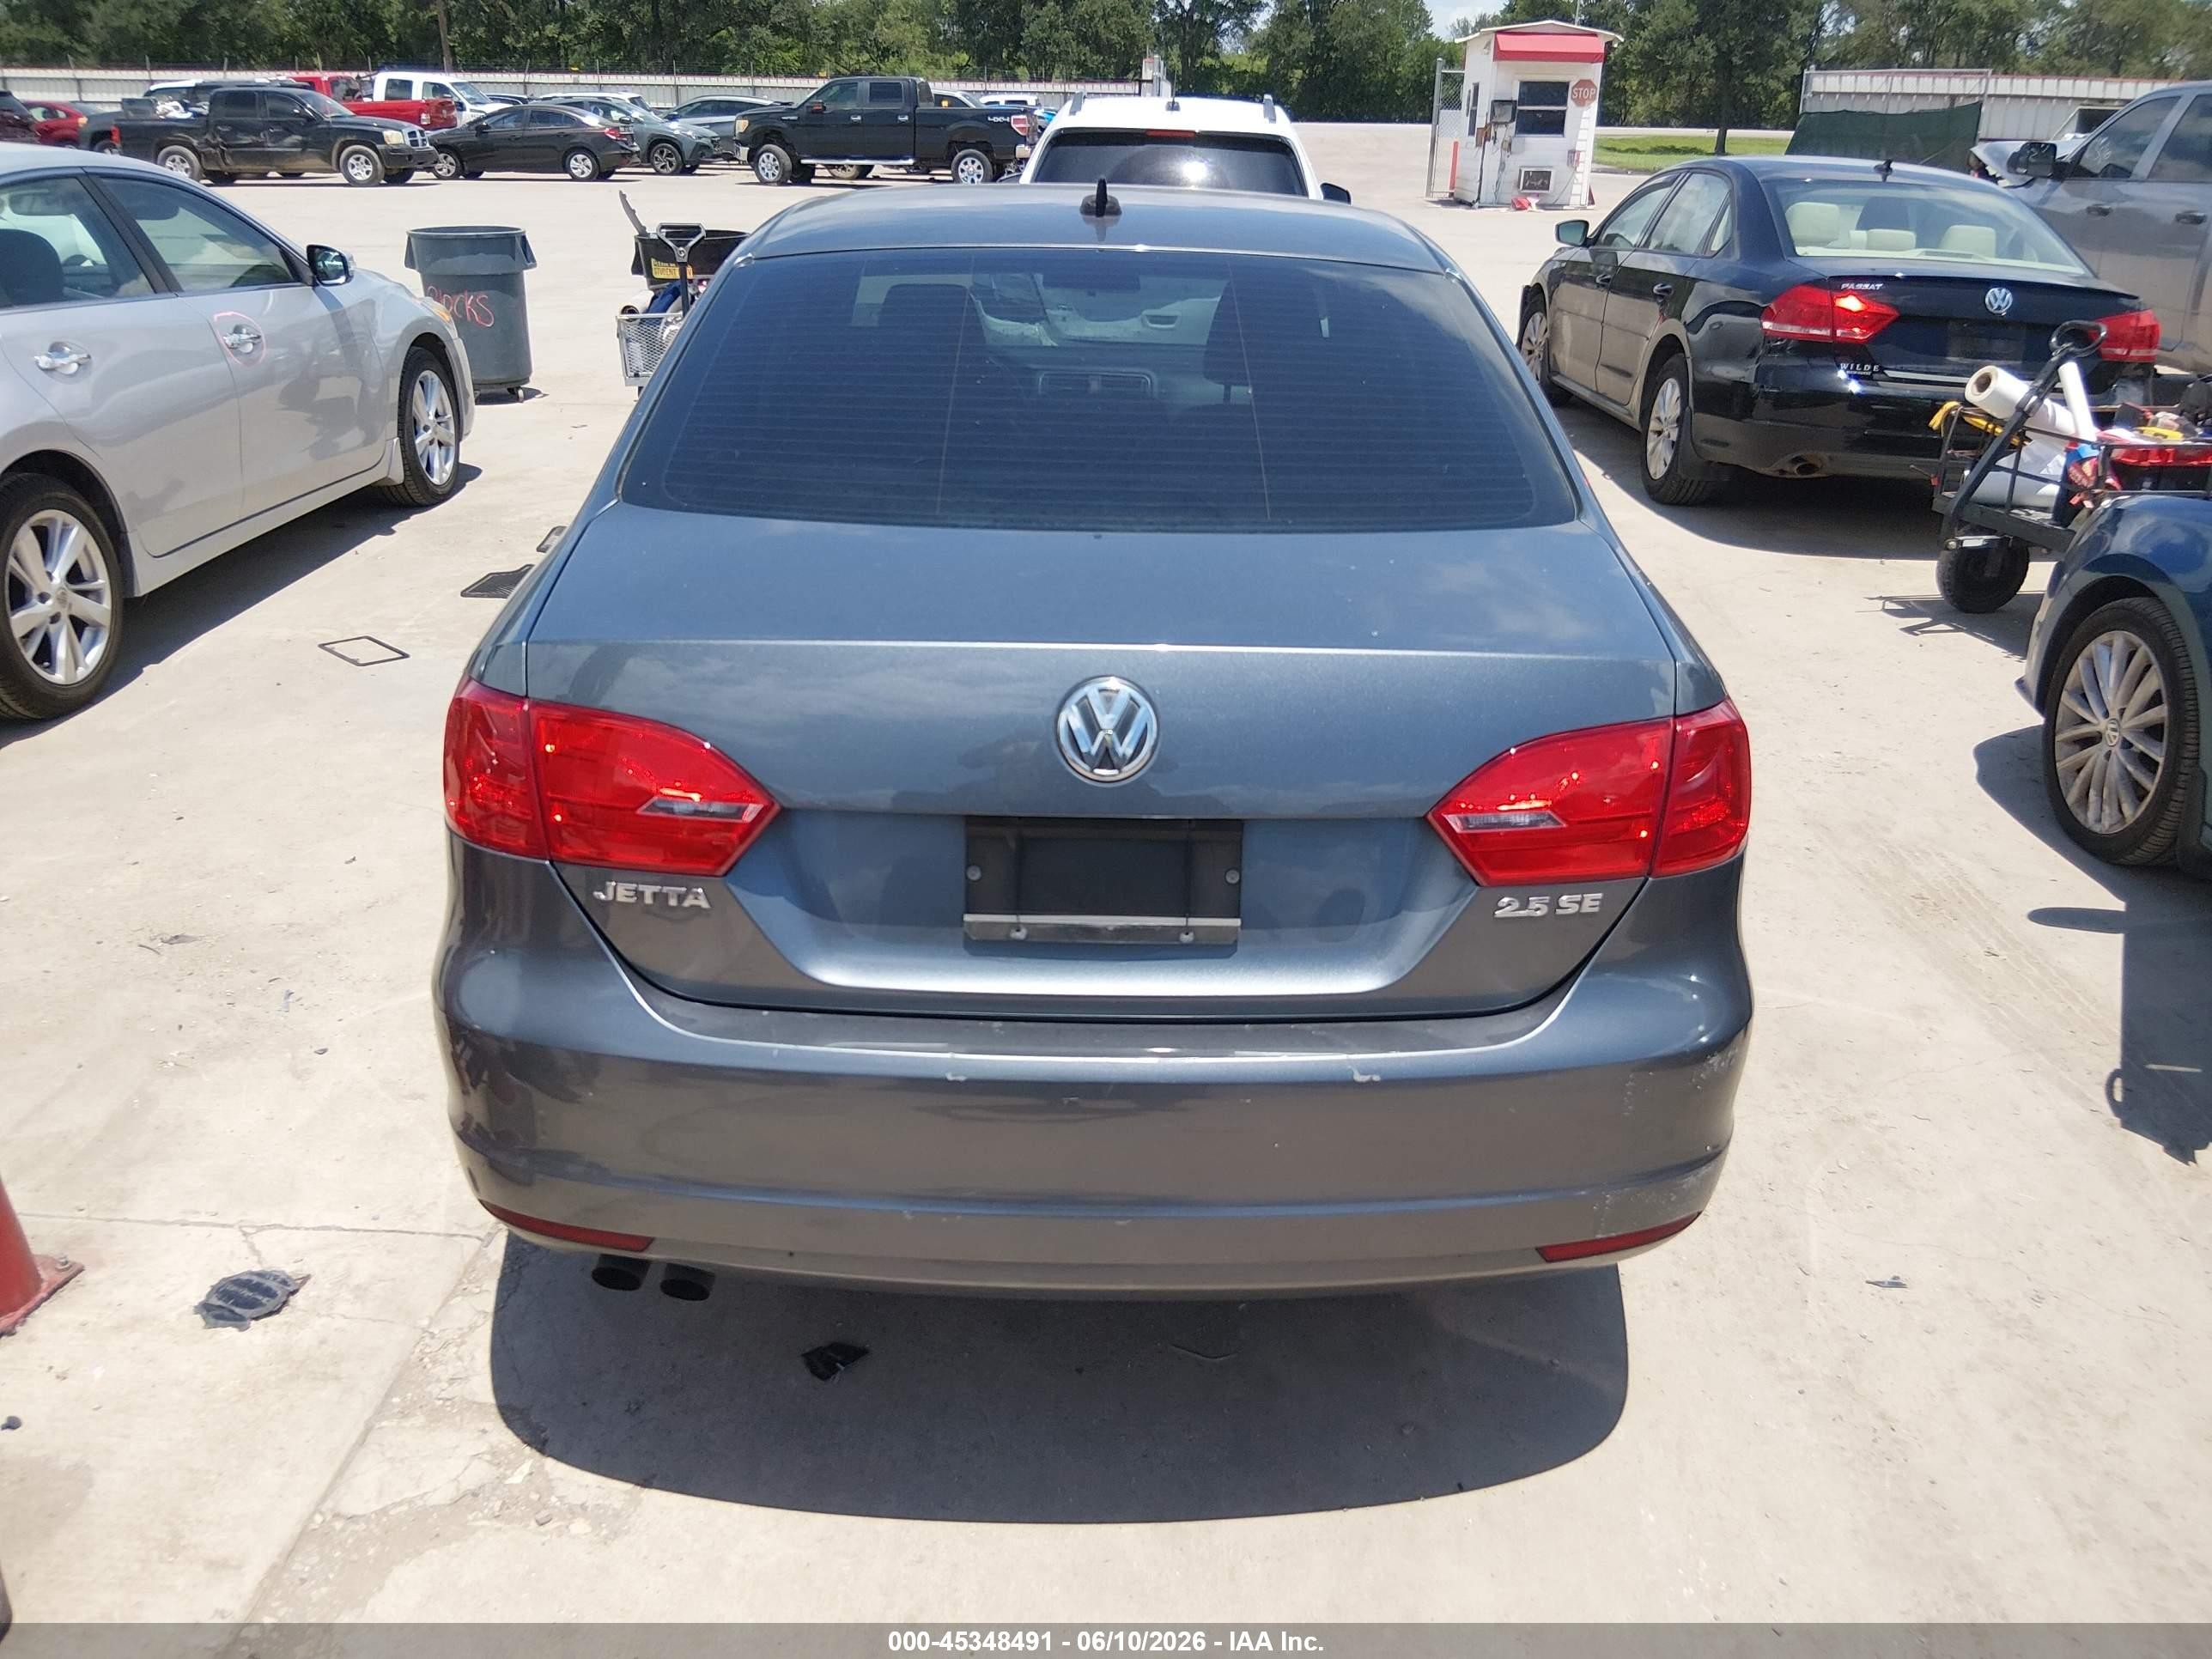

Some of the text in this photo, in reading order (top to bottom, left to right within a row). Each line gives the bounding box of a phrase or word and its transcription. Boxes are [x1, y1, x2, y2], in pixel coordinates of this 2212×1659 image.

[1572, 88, 1595, 100] STOP
[1985, 288, 2013, 314] VW
[1840, 363, 1880, 372] WILDE
[1057, 676, 1158, 783] VW
[592, 881, 711, 908] JETTA
[1494, 893, 1604, 918] 2.5 SE
